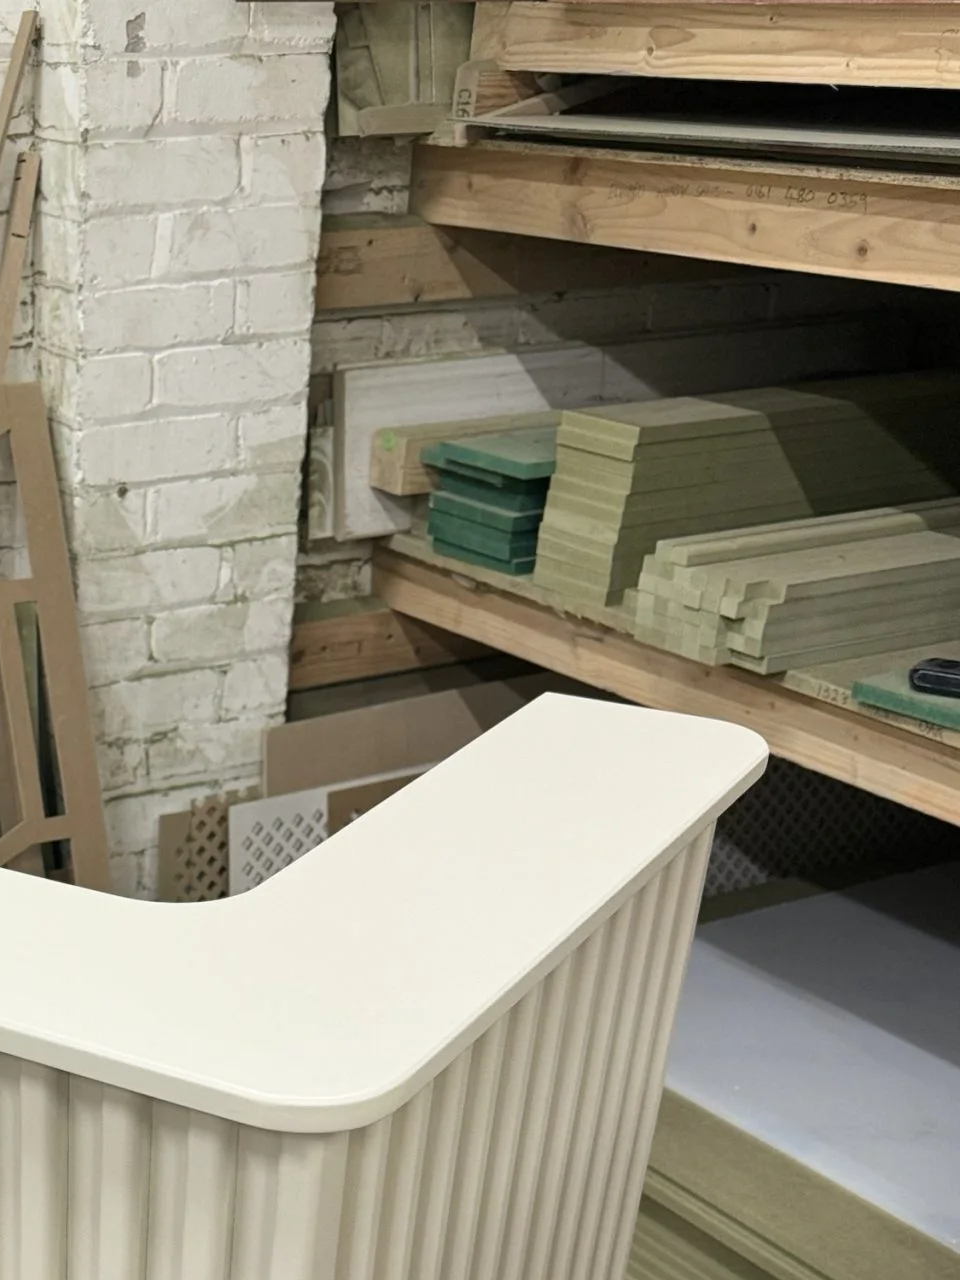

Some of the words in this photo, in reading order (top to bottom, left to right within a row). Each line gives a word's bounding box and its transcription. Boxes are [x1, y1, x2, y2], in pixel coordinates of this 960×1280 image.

[455, 88, 472, 118] C16
[784, 184, 815, 208] 480
[827, 190, 869, 215] 0359
